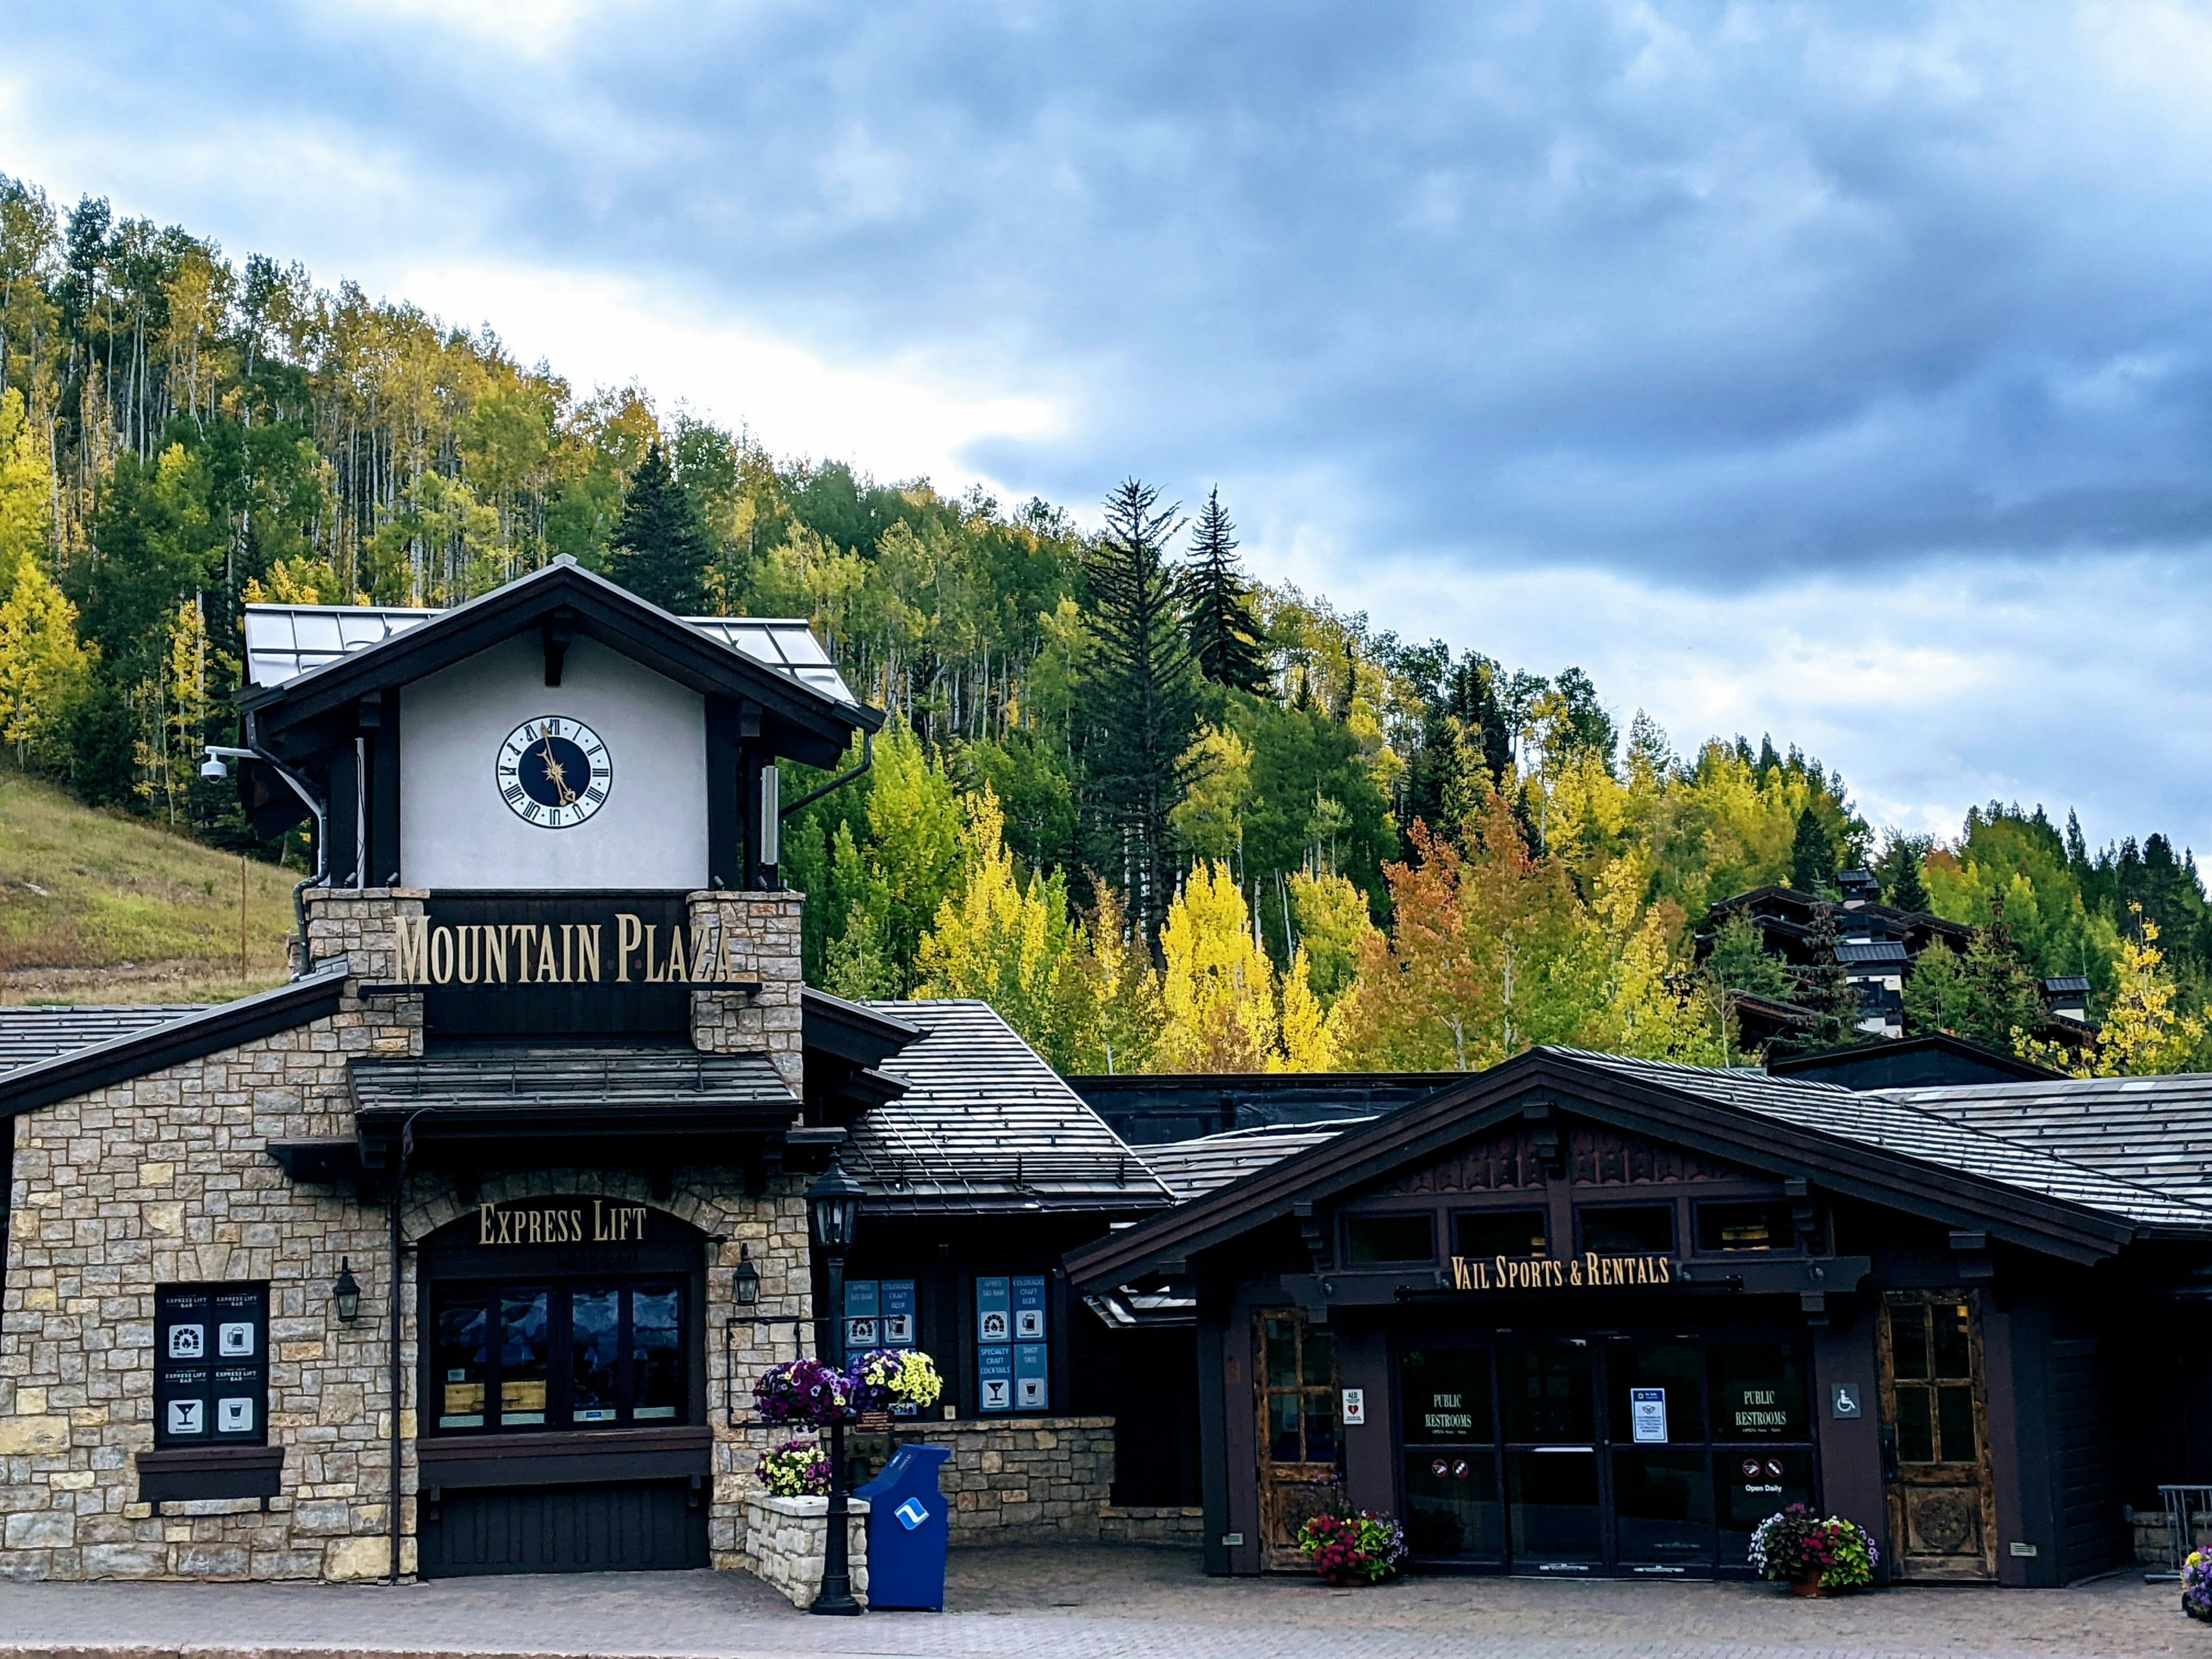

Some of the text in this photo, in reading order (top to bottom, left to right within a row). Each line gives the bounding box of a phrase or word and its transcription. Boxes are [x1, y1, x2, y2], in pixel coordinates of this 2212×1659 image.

[392, 914, 733, 984] MOUNTAIN PLAZA
[479, 1200, 646, 1244] EXPRESS LIFT
[1450, 1252, 1669, 1289] VAIL SPORTS & RENTALS
[1434, 1394, 1461, 1408] PUBLIC
[1744, 1391, 1775, 1404] PUBLIC
[1425, 1414, 1472, 1427] RESTROOMS
[1736, 1411, 1786, 1426] RESTROOMS
[1765, 1484, 1782, 1492] Daily
